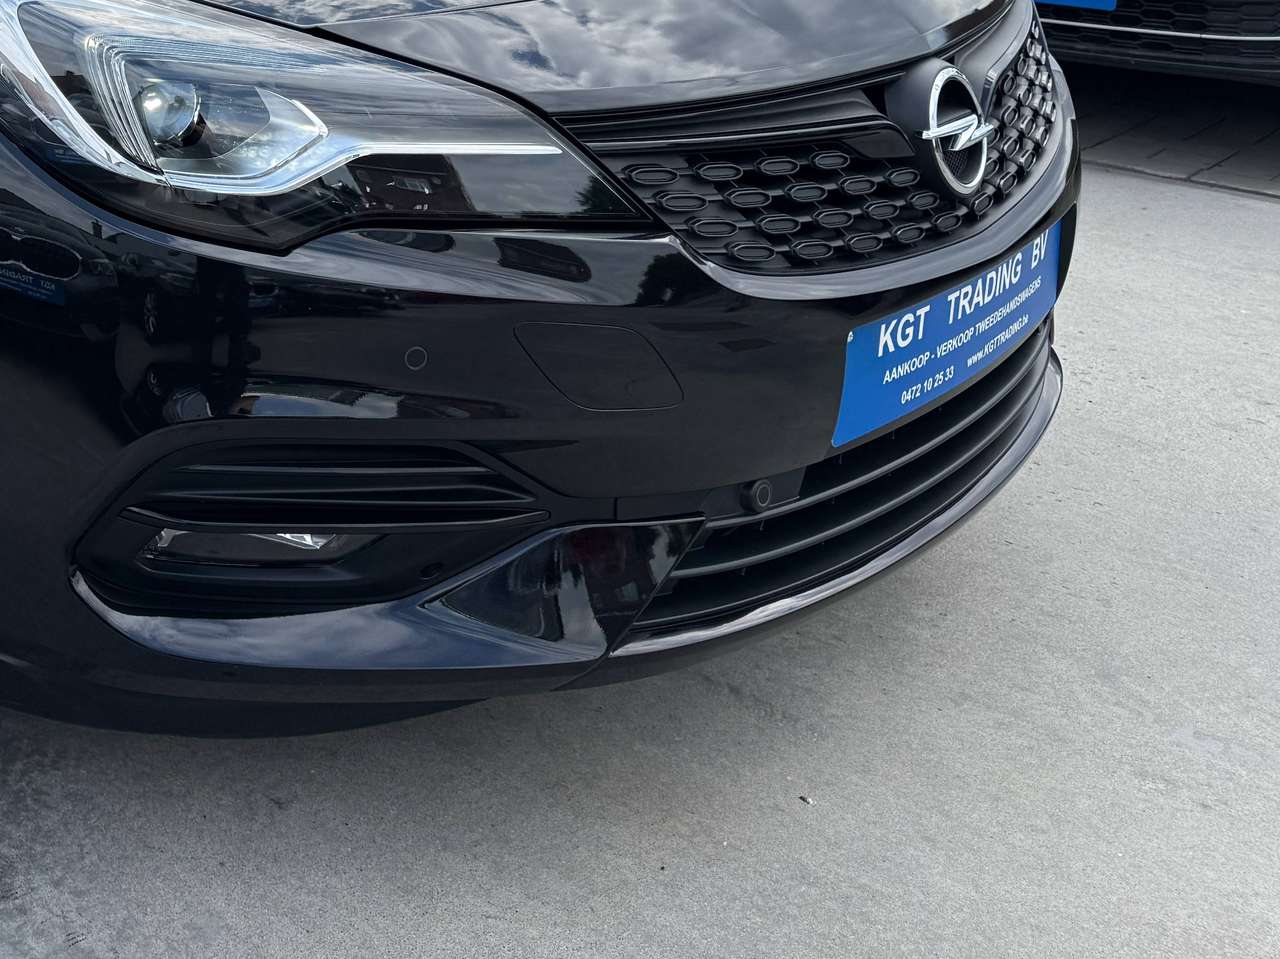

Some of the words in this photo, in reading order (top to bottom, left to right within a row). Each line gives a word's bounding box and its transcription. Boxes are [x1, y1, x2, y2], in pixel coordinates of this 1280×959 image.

[877, 304, 931, 358] KGT
[946, 251, 1023, 325] TRADING
[1030, 229, 1050, 270] BV
[882, 351, 931, 384] AANKOOP
[936, 327, 974, 359] VERKOOP
[975, 275, 1042, 336] TWEEDEHANDSWAGENS
[900, 383, 921, 404] 0472
[923, 378, 933, 392] 10
[933, 371, 944, 388] 25
[944, 365, 955, 380] 33
[966, 313, 1029, 368] www.KGTTRADING.be
